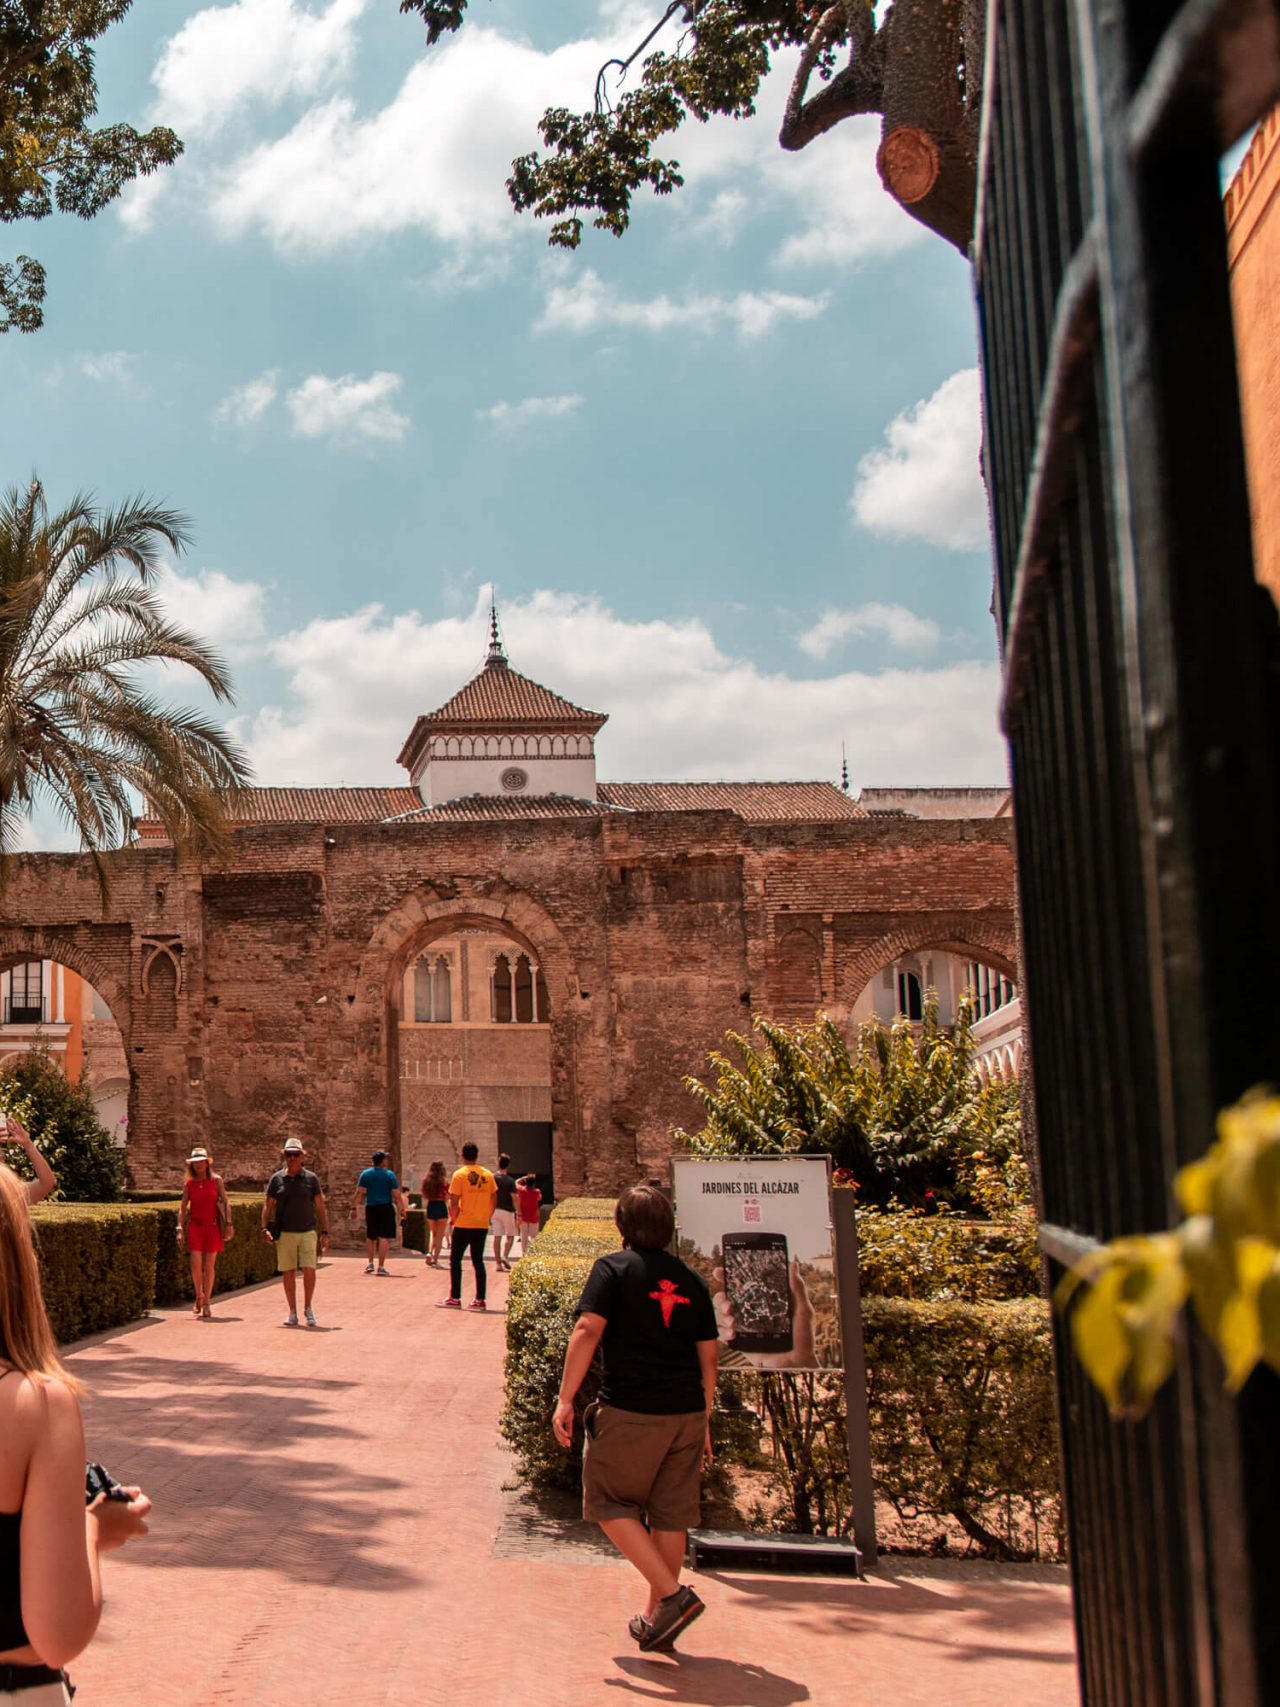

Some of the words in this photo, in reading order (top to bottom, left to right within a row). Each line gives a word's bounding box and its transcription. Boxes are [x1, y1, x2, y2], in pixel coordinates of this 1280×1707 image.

[702, 1182, 741, 1194] JARDINES
[743, 1182, 759, 1194] DEL
[761, 1179, 800, 1194] ALCÁZAR
